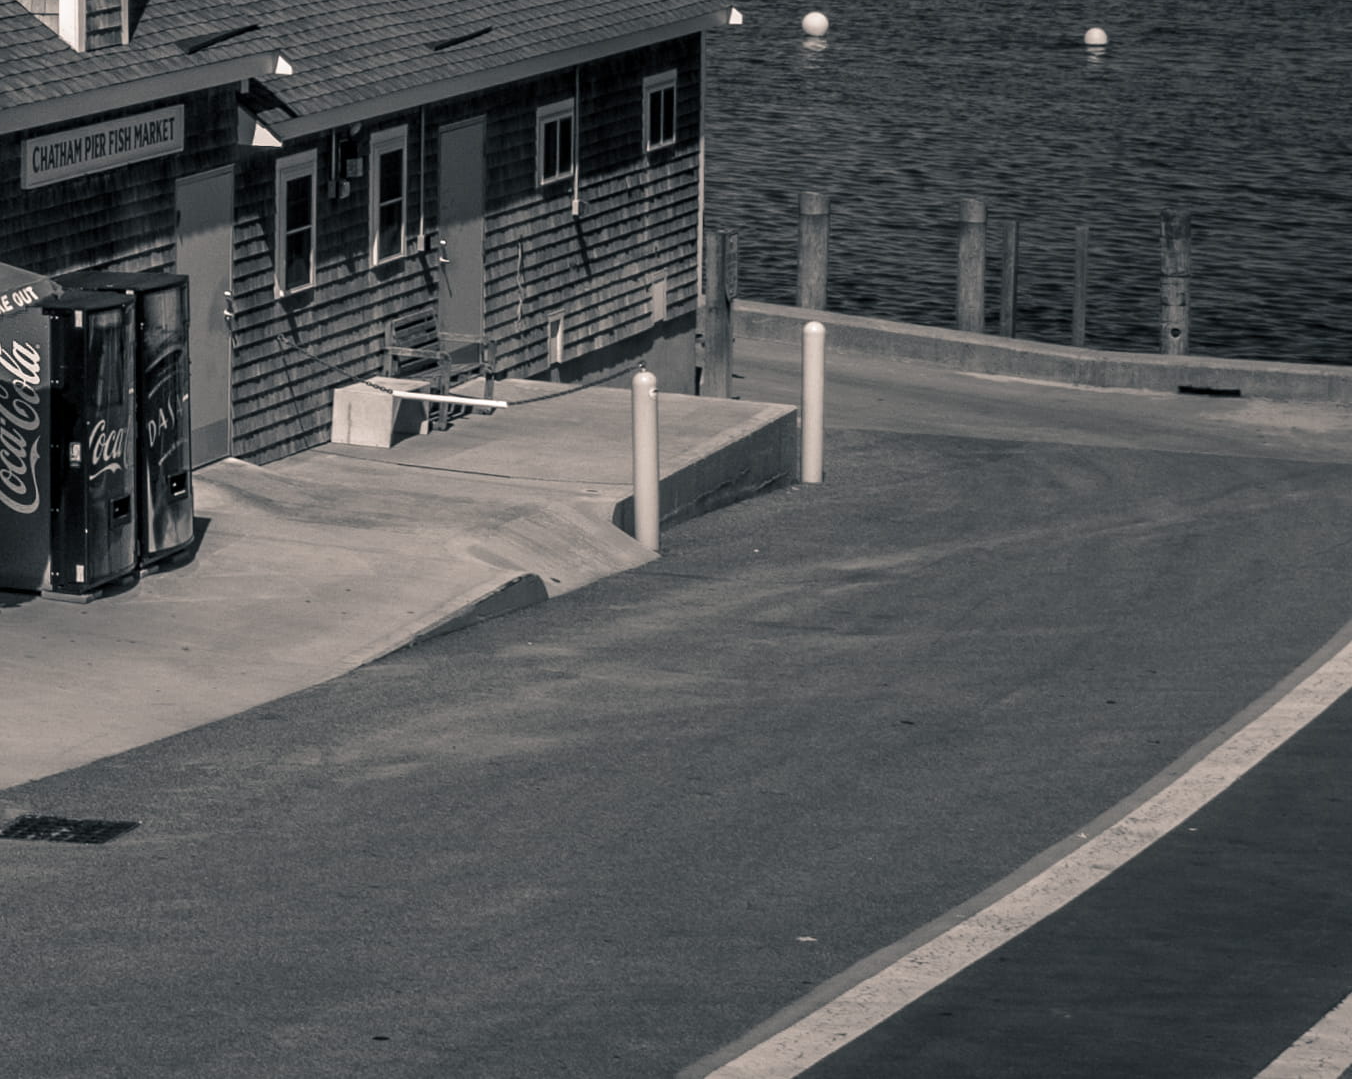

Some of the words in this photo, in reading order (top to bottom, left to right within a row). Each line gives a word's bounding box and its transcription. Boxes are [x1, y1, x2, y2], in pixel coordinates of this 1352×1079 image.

[32, 137, 83, 173] CHATHAM
[84, 133, 106, 161] PIER
[108, 125, 132, 156] FISH
[133, 116, 176, 149] MARKET
[12, 285, 39, 308] OUT
